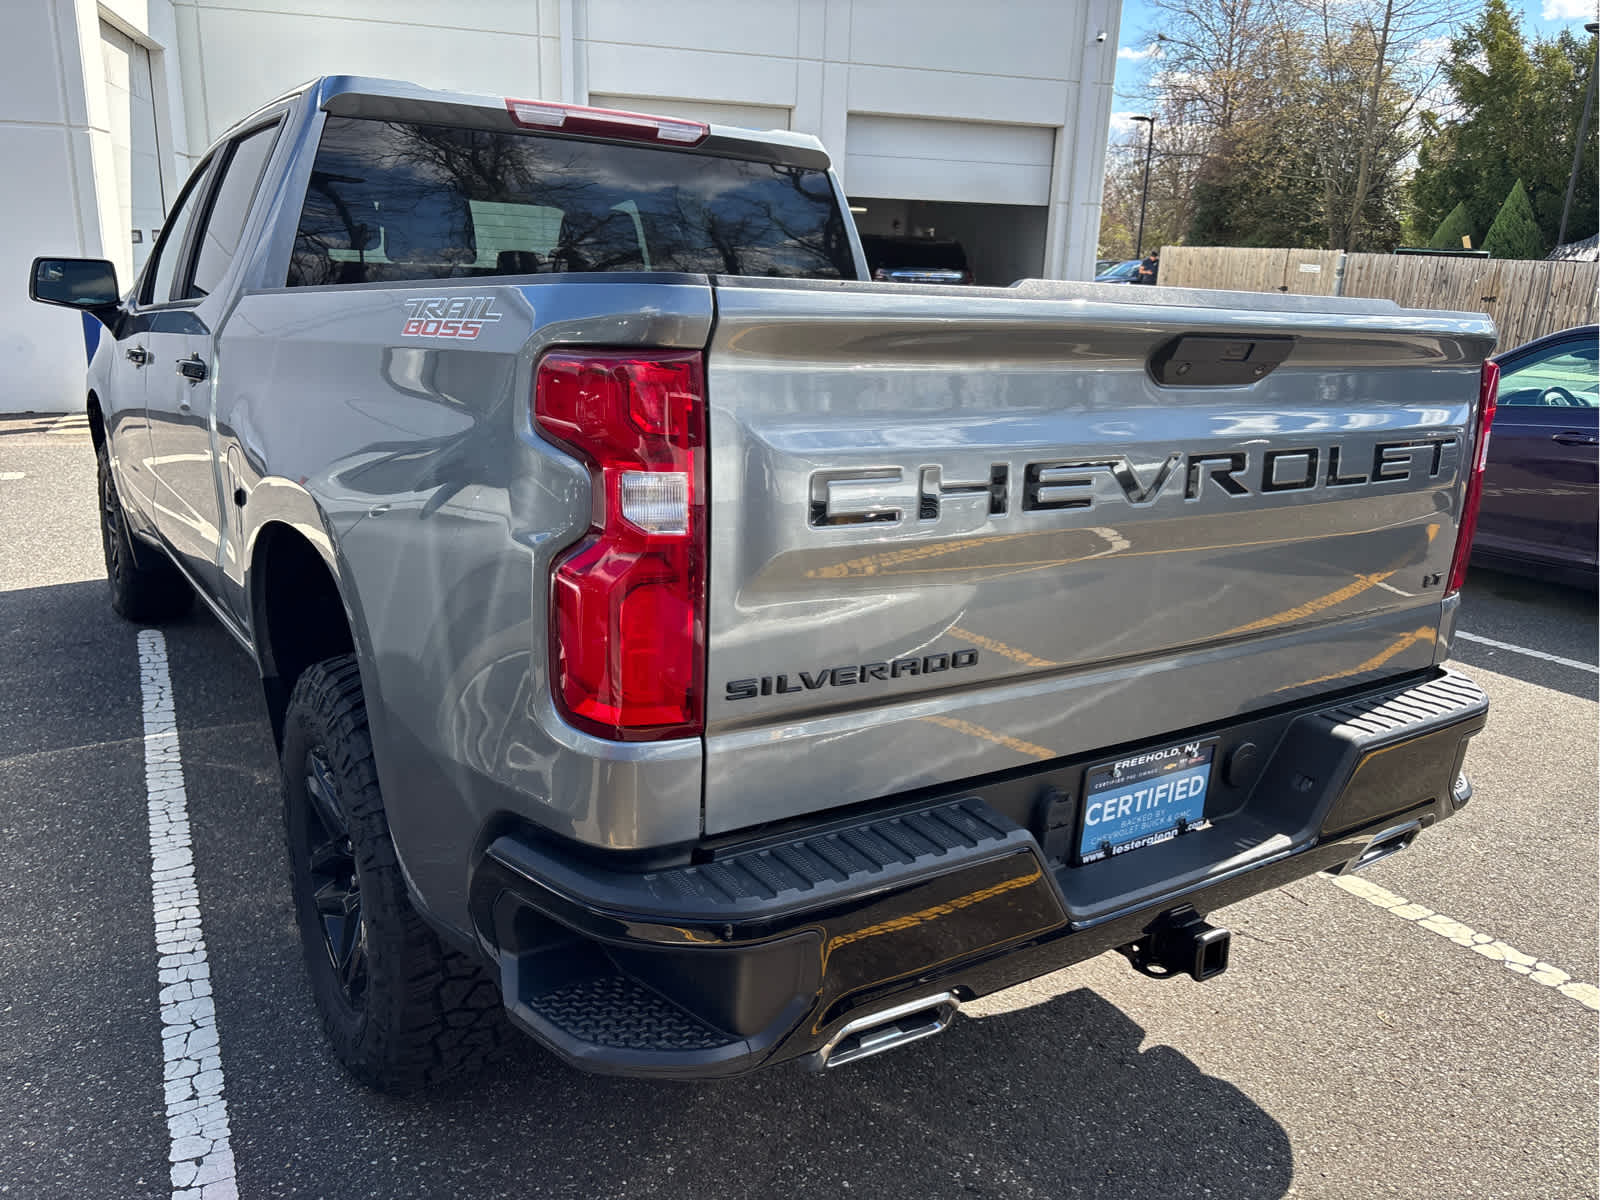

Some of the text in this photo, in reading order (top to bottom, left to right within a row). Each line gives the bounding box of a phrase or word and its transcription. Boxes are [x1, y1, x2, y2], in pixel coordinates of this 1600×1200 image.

[404, 296, 503, 322] TRAIL
[400, 319, 484, 340] BOSS
[807, 438, 1458, 529] CHEVROLET
[1422, 573, 1441, 588] LT
[725, 648, 979, 701] SILVERADO
[1184, 742, 1201, 754] NJ
[1085, 775, 1205, 826] CERTIFIED
[1090, 823, 1139, 846] CHEVROLET
[1141, 816, 1166, 830] BUICK
[1174, 809, 1192, 820] GMC
[1120, 809, 1166, 828] BACKED BY
